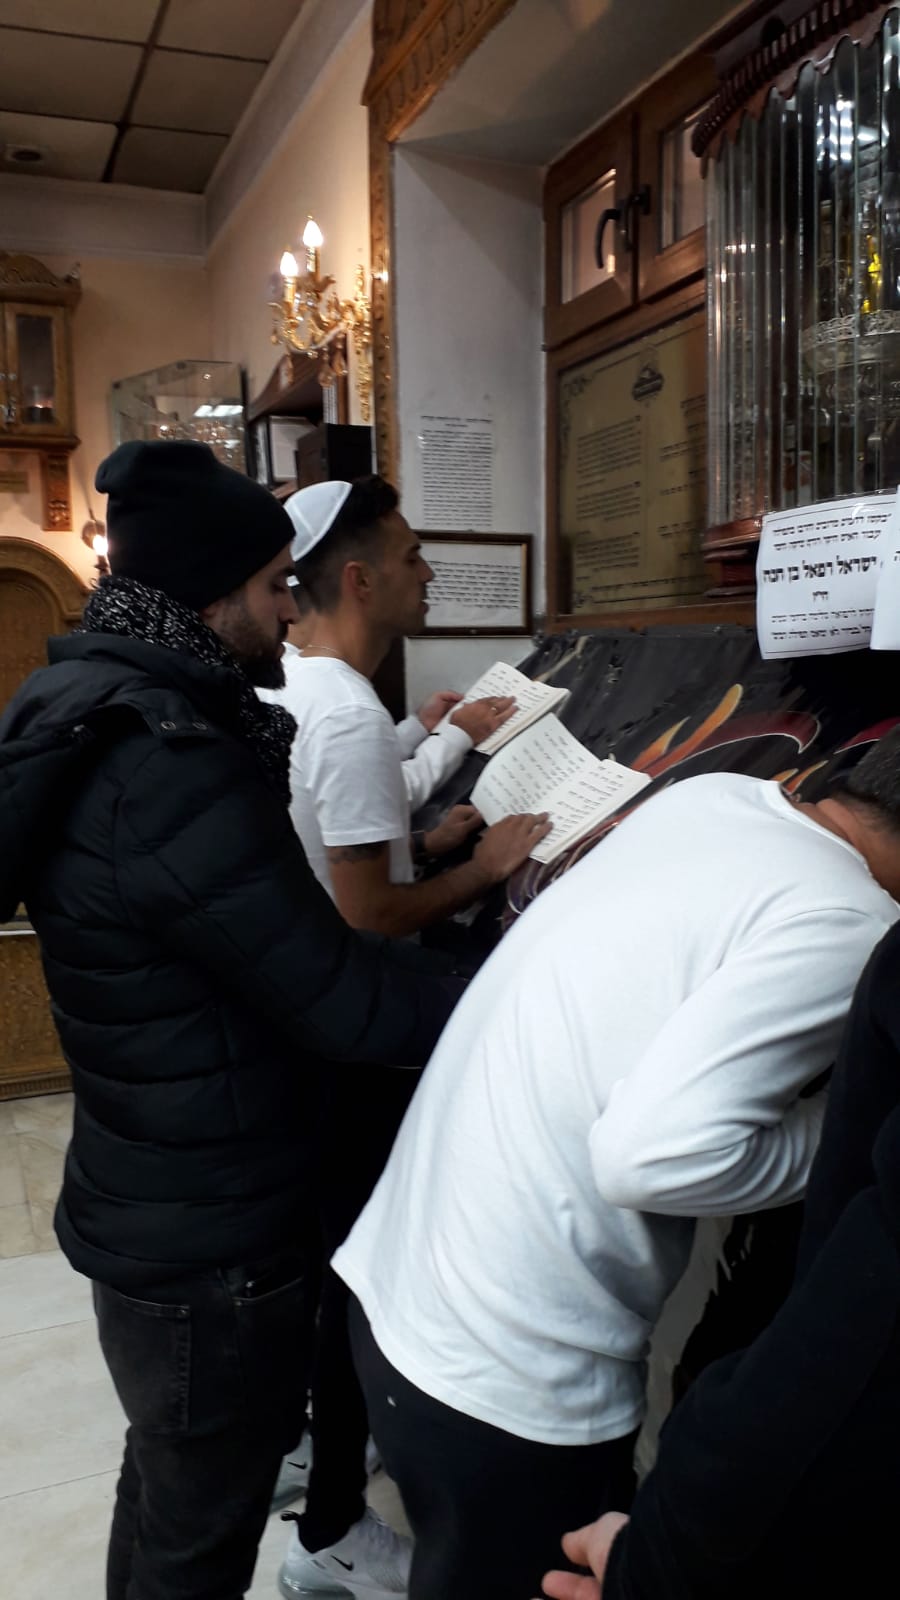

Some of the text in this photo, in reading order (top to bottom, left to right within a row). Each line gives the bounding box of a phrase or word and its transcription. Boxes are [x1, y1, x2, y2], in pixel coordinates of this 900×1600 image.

[802, 560, 833, 579] רפאל
[836, 555, 877, 575] ישראל
[763, 568, 784, 583] חנה
[788, 566, 800, 583] בן
